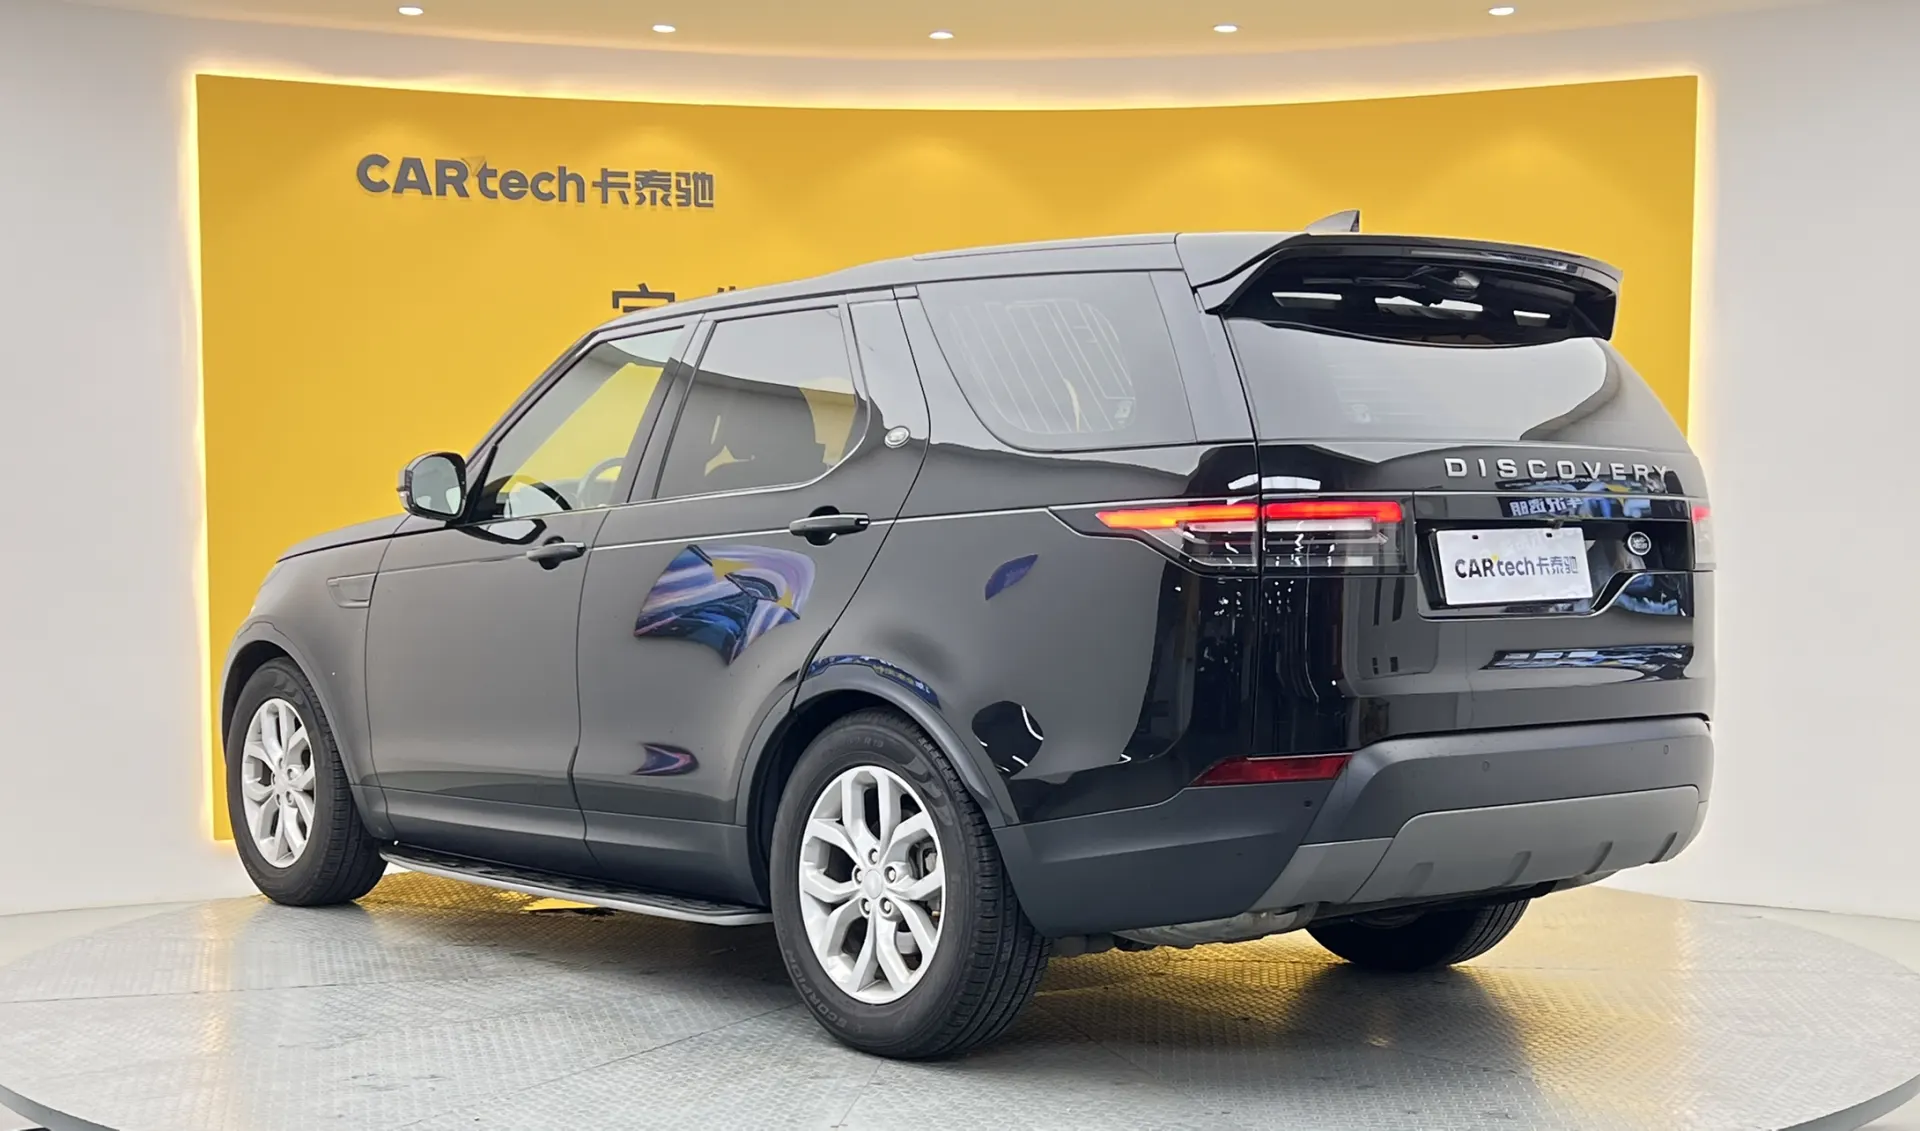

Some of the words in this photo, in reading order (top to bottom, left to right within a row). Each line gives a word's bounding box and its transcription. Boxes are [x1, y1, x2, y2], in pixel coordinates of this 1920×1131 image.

[592, 168, 714, 208] 卡泰驰
[1444, 458, 1669, 481] DISCOVERY
[1536, 556, 1579, 576] 卡泰驰
[785, 949, 848, 1028] SCORPION
